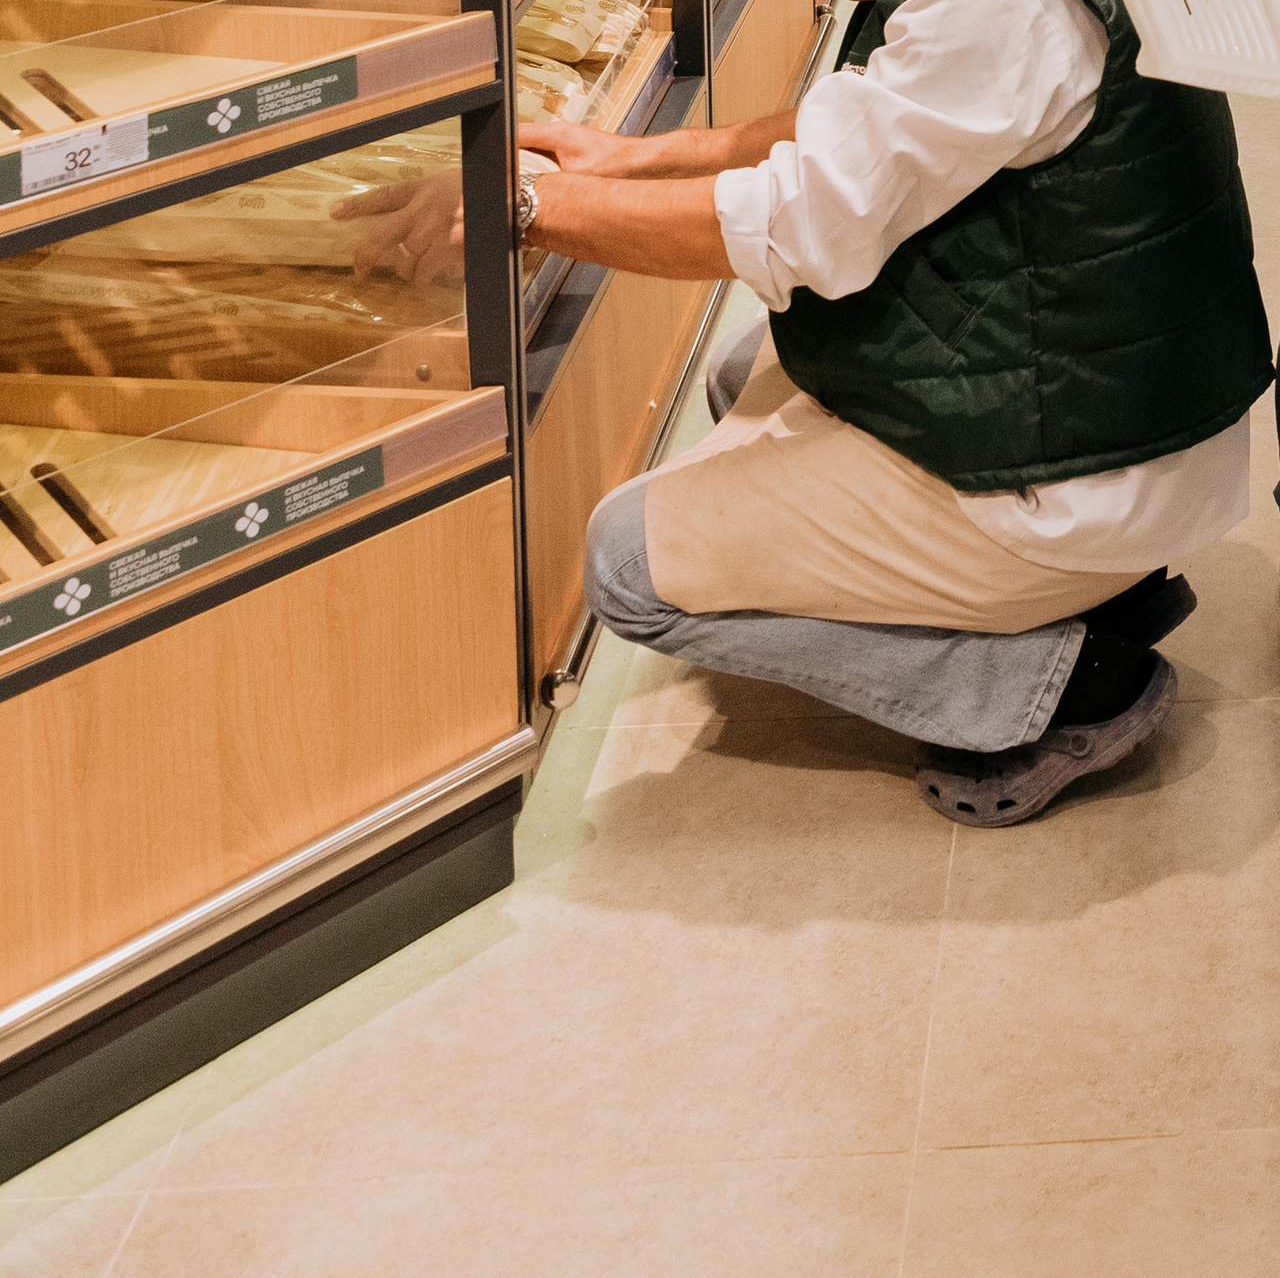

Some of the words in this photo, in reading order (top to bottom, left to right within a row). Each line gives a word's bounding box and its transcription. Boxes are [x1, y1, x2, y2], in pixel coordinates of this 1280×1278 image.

[256, 79, 291, 95] СВЕЖАЯ
[264, 85, 301, 103] ВКУСНАЯ
[301, 74, 338, 90] ВЫПЕЧКА
[257, 88, 322, 113] СОБСТВЕННОГО
[257, 96, 322, 122] ПРОИЗВОДСТВА
[64, 147, 92, 172] 32
[285, 476, 318, 495] СВЕЖАЯ
[292, 480, 329, 502] ВКУСНАЯ
[329, 465, 365, 486] ВЫПЕЧКА
[285, 481, 349, 514] СОБСТВЕННОГО
[285, 490, 349, 523] ПРОИЗВОДСТВА
